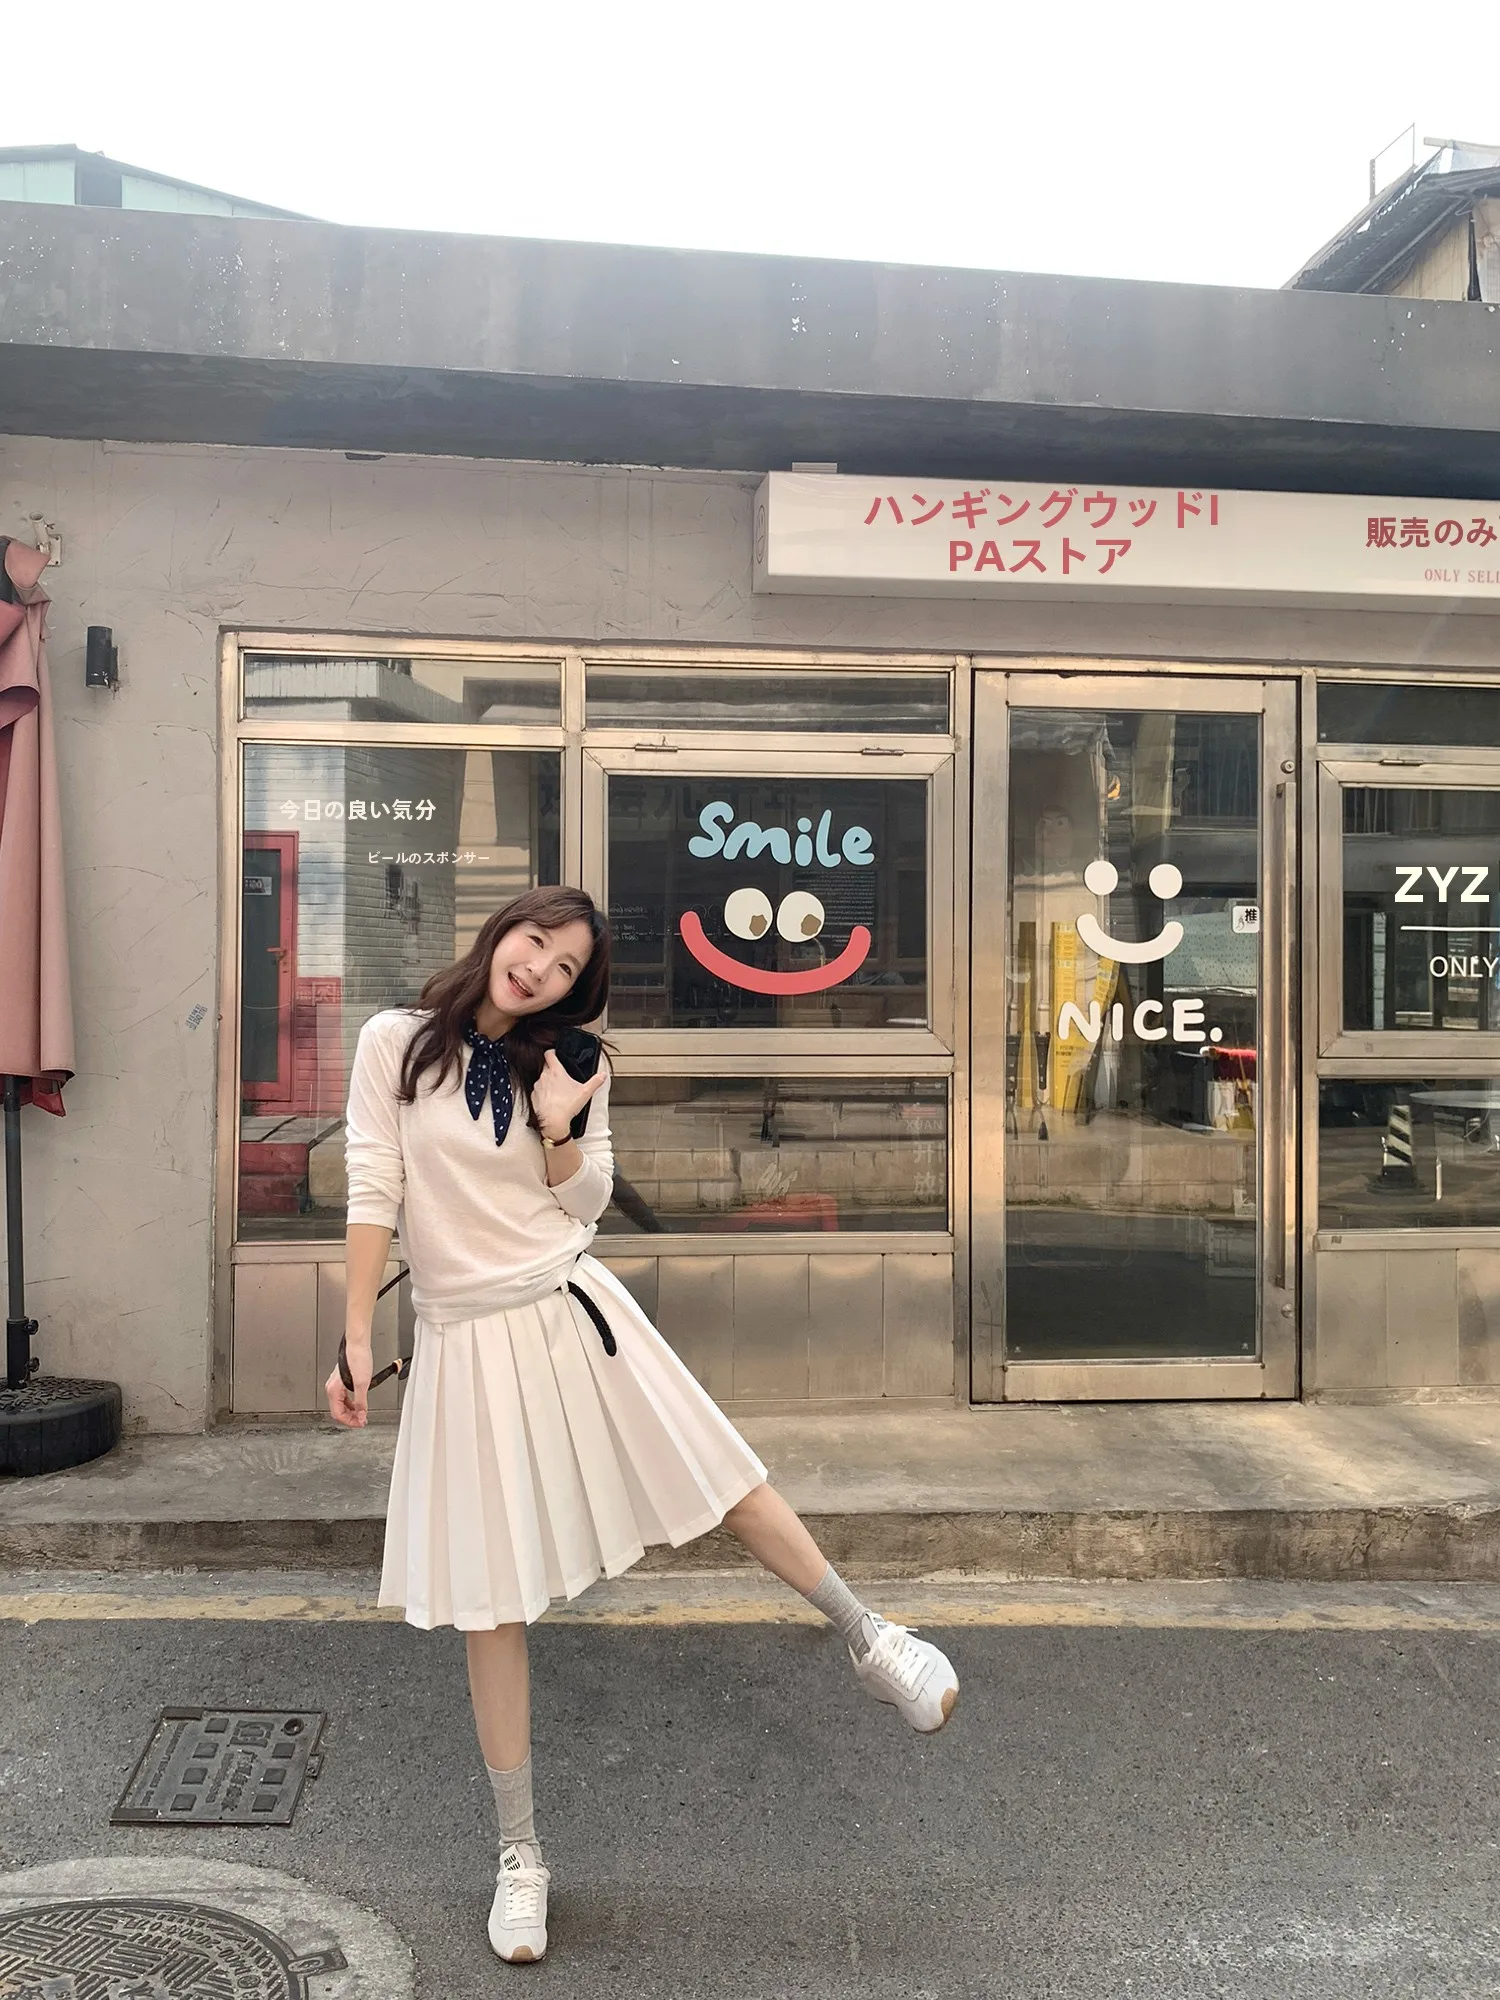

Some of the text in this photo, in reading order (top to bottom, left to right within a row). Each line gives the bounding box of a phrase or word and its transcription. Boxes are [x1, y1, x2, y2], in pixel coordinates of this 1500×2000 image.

[1365, 516, 1498, 548] 販売のみ
[949, 537, 1133, 575] PAストア
[1424, 568, 1461, 582] ONLY
[279, 798, 437, 821] 今日の良い気分
[687, 800, 876, 869] Smile
[1394, 866, 1490, 903] ZYZ
[1244, 907, 1258, 922] 推
[1429, 955, 1499, 978] ONLY
[1057, 998, 1224, 1043] NICE.
